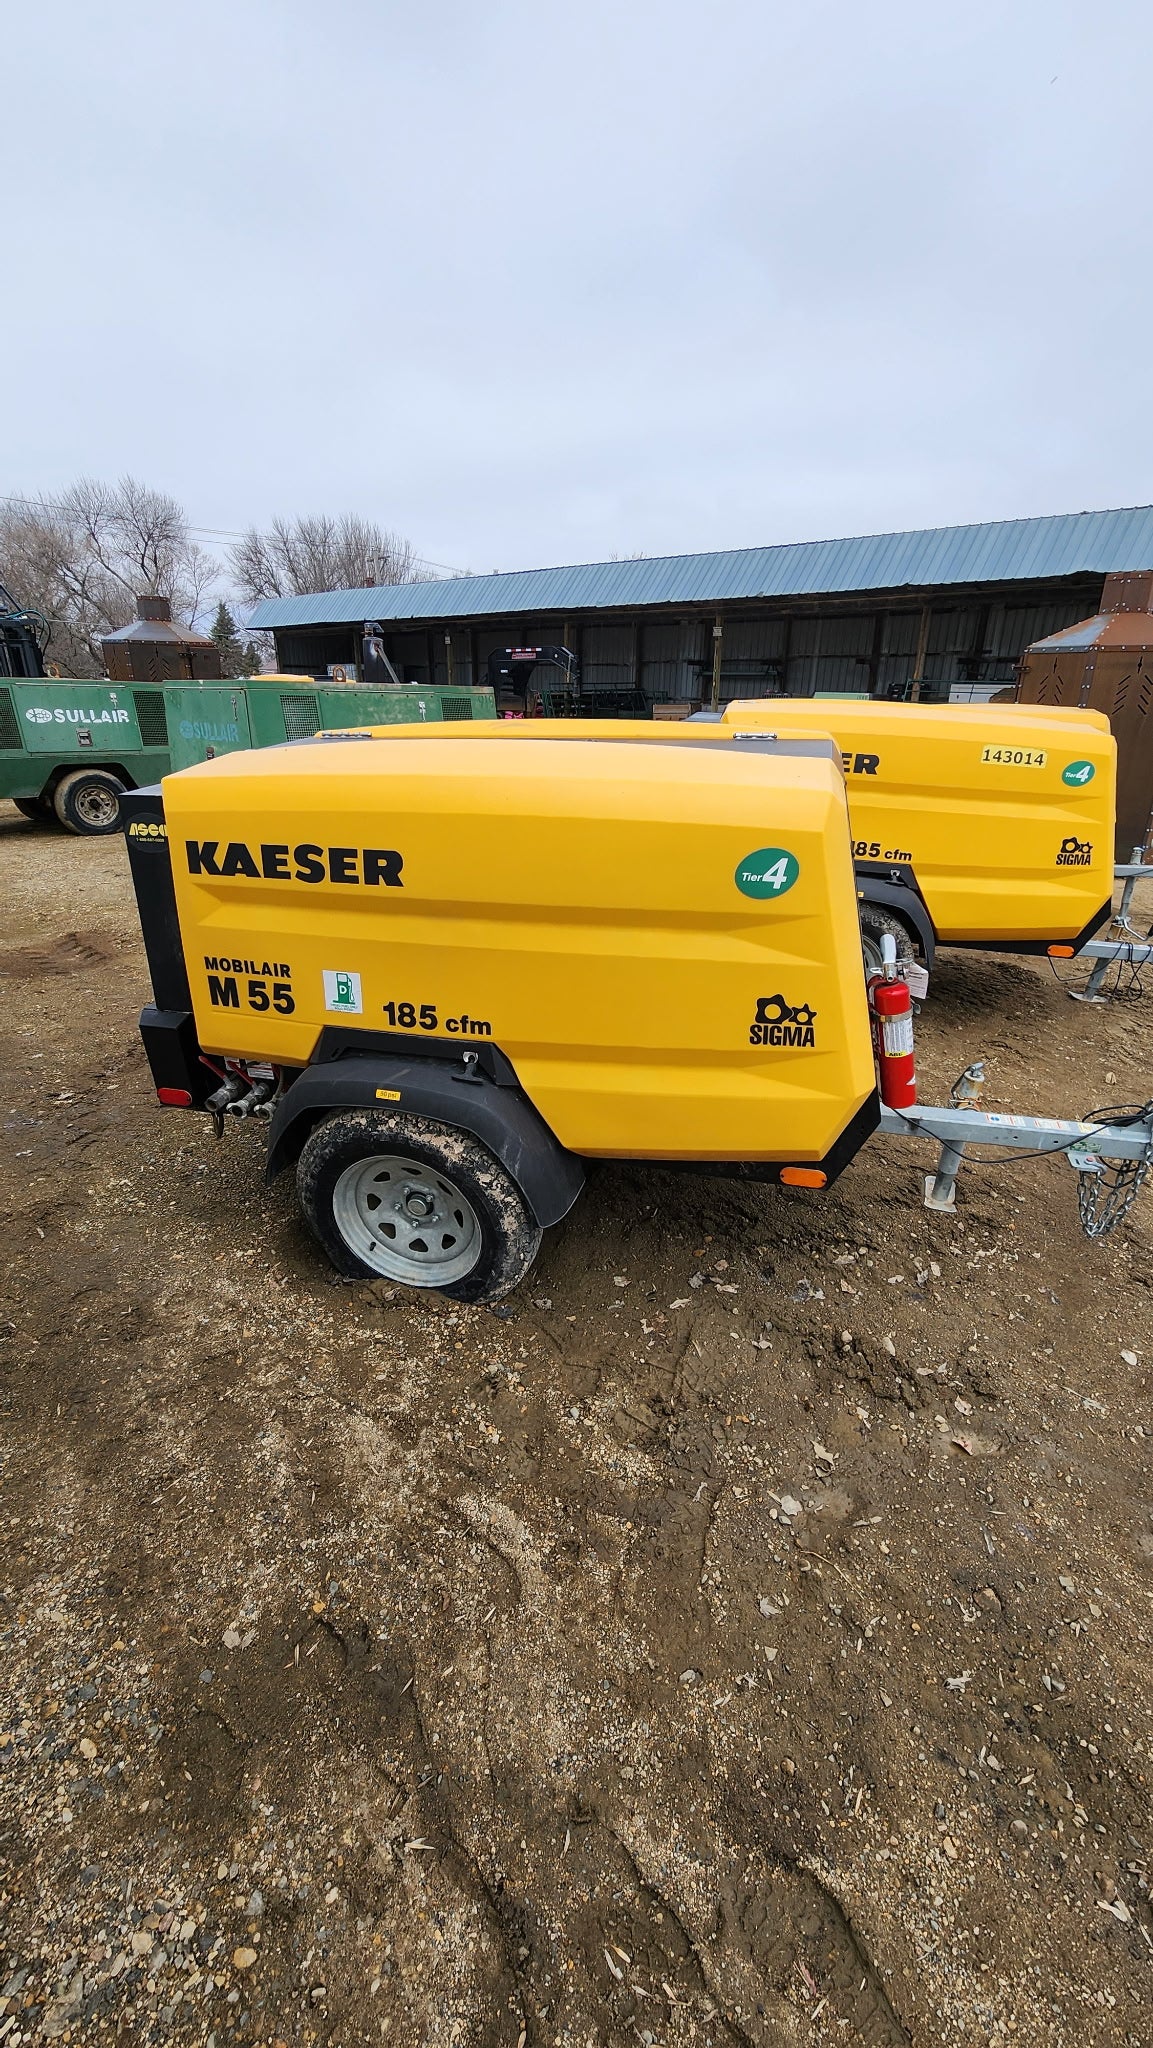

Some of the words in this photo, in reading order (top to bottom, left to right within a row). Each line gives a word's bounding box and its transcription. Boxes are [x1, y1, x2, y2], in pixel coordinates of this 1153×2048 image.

[53, 708, 130, 724] SULLAIR
[192, 721, 240, 742] SULLAIR
[982, 749, 1044, 766] 143014
[185, 840, 404, 887] KAESER
[884, 849, 912, 861] cfm
[1055, 853, 1091, 866] SIGMA
[204, 956, 291, 978] MOBILAIR
[207, 975, 240, 1008] M
[248, 980, 295, 1015] 55
[383, 1001, 438, 1030] 185
[445, 1014, 492, 1036] cfm
[749, 1024, 815, 1047] SIGMA
